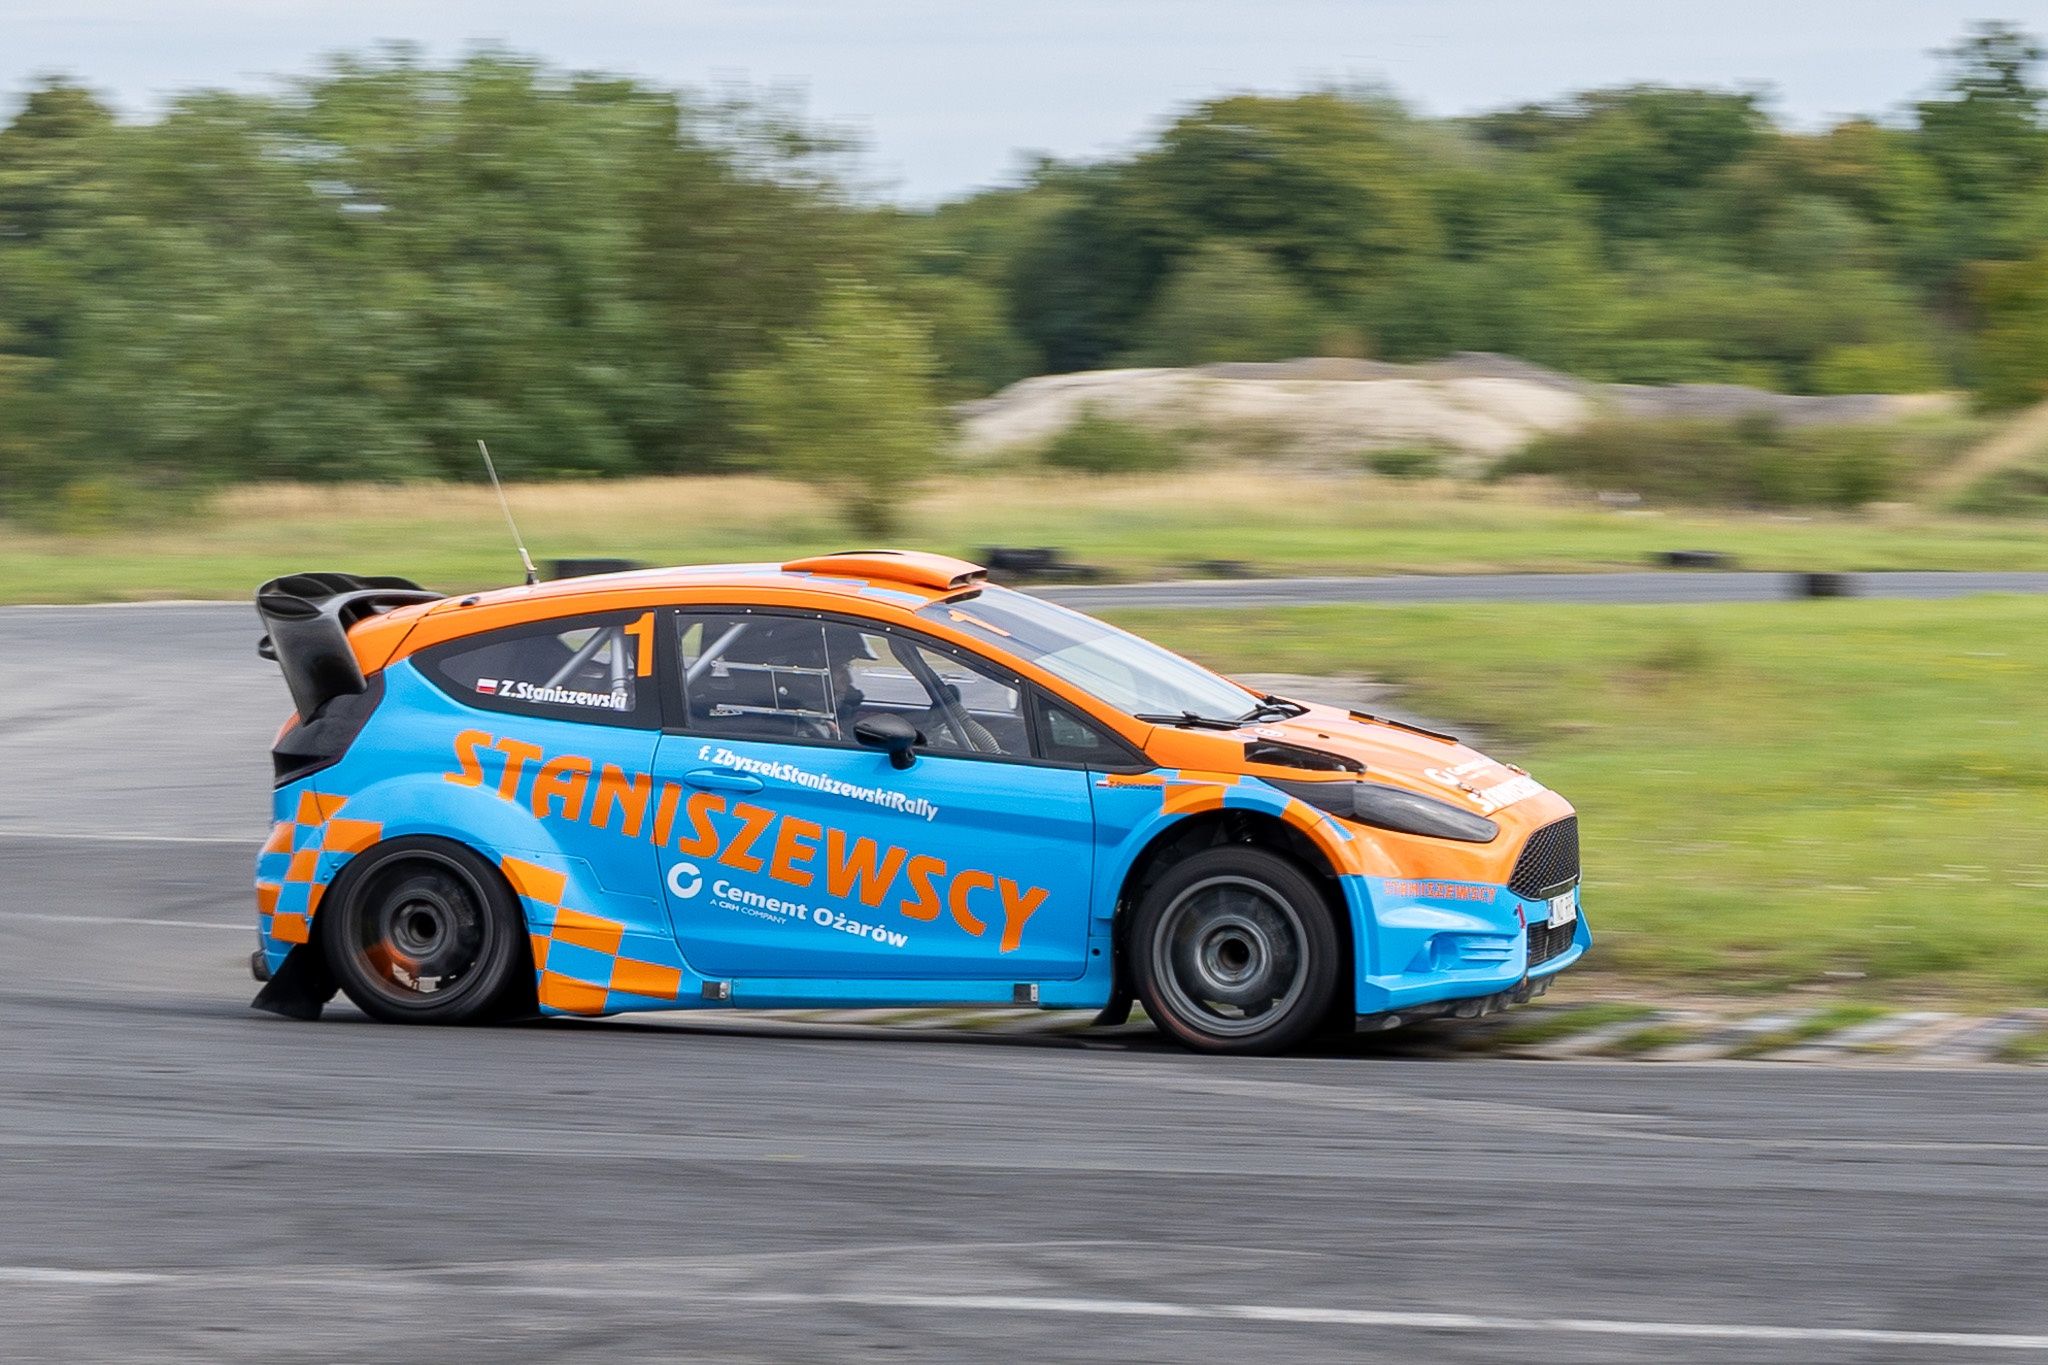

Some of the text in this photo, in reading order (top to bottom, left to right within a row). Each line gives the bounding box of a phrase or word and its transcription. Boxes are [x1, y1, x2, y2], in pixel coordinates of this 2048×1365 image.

[624, 612, 655, 677] 1
[499, 679, 628, 708] Z.Staniszewski
[711, 748, 938, 822] ZbyszekStaniszewskiRally
[443, 729, 1050, 953] STANISZEWSCY
[713, 880, 908, 948] Cement Ożarów
[741, 906, 787, 924] COMPANY
